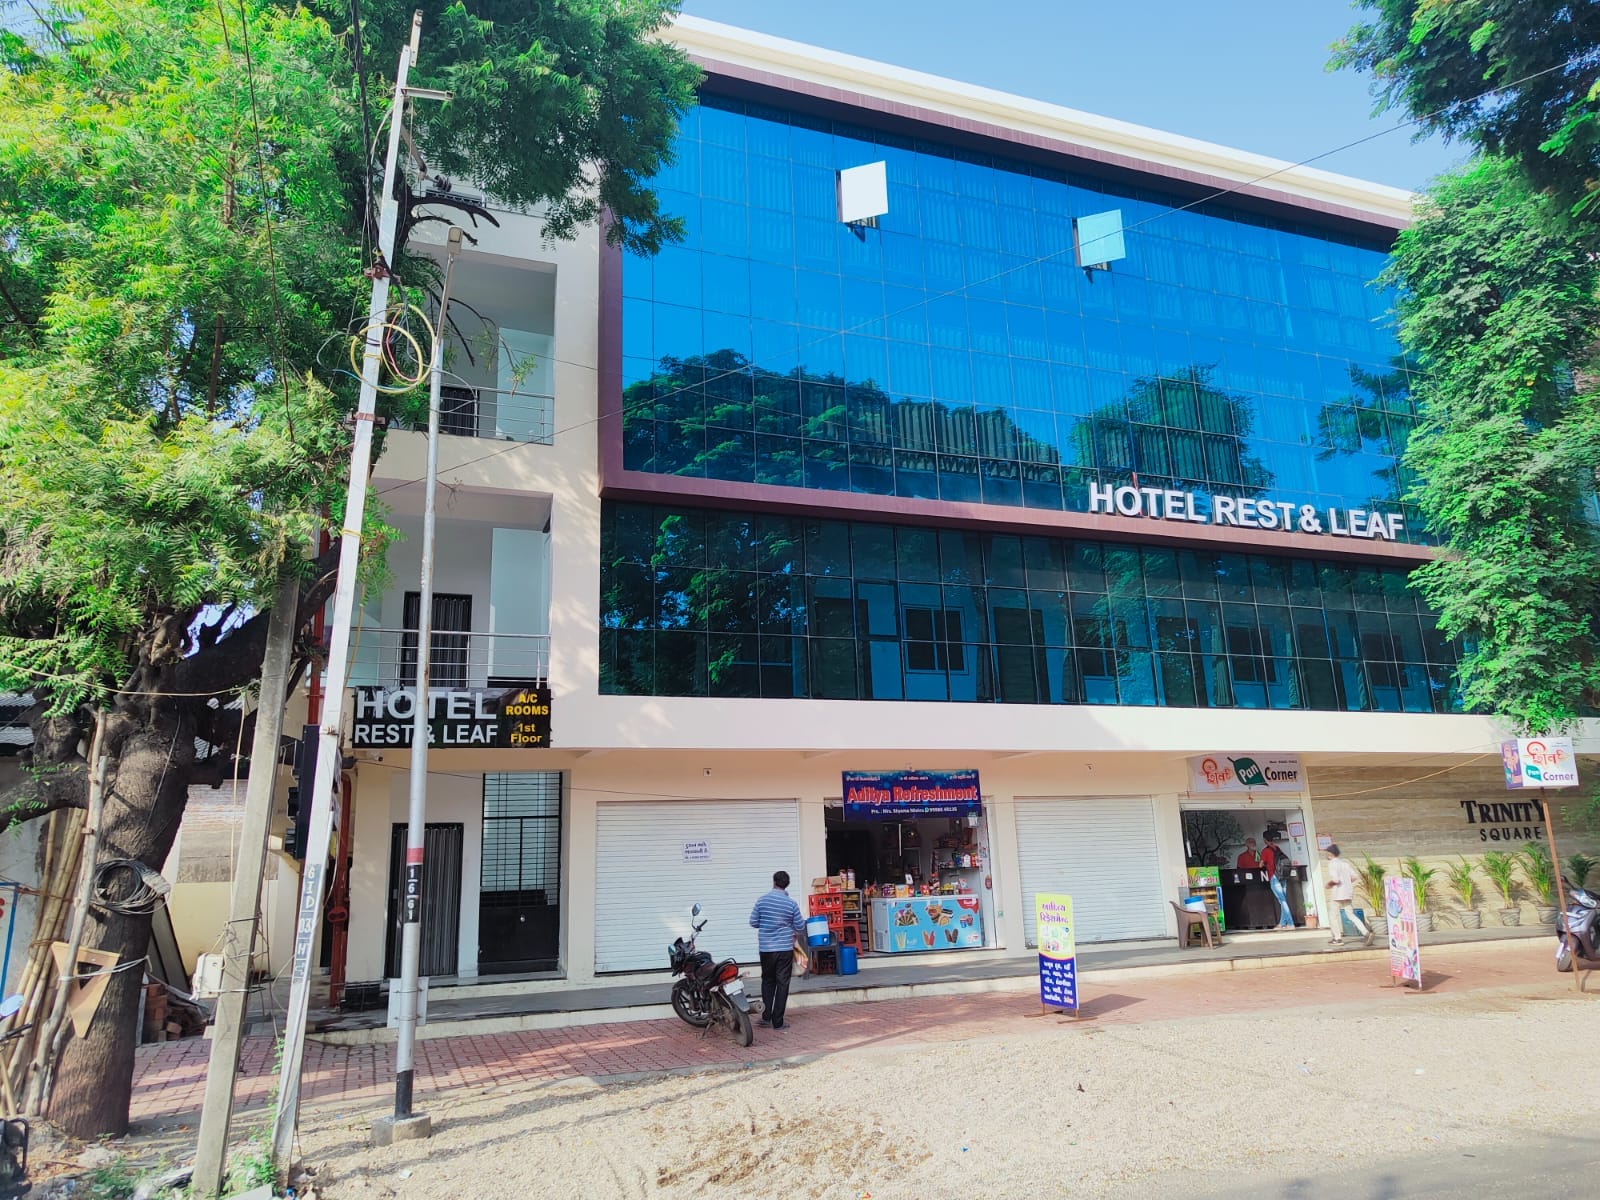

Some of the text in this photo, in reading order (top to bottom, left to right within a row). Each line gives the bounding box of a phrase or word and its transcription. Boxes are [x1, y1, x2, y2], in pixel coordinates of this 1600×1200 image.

[1090, 482, 1403, 540] HOTEL REST & LEAF
[356, 690, 497, 720] HOTEL
[518, 693, 538, 703] A/C
[505, 705, 549, 716] ROOMS
[354, 724, 415, 744] REST
[443, 724, 499, 744] LEAF
[518, 723, 536, 732] 1st
[510, 734, 542, 744] Floor
[1239, 764, 1298, 782] Pan Corner
[1543, 772, 1574, 781] Corner
[847, 785, 978, 806] Aditya Refreshment
[1460, 799, 1546, 824] TRINITY
[1480, 826, 1542, 842] SQUARE
